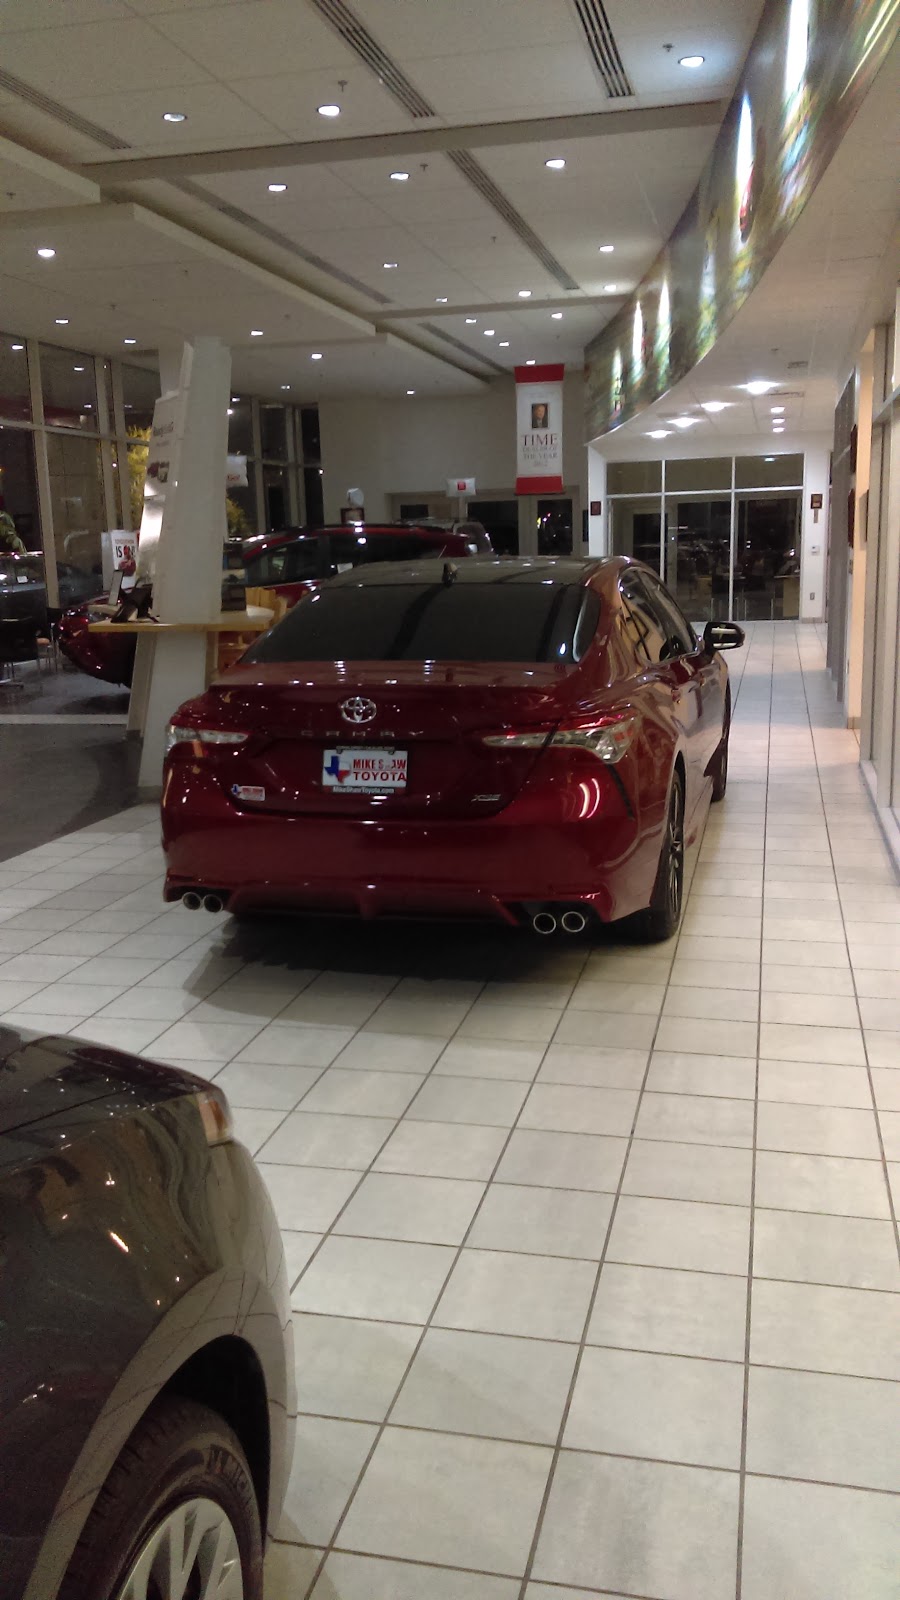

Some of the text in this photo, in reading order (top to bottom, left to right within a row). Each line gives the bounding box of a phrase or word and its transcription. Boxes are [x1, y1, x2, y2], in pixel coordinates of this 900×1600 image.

[521, 433, 558, 446] TIME
[115, 545, 123, 558] IS
[300, 729, 424, 738] CAMRY
[353, 758, 407, 770] MIKE SAW
[353, 771, 407, 782] TOYOTA
